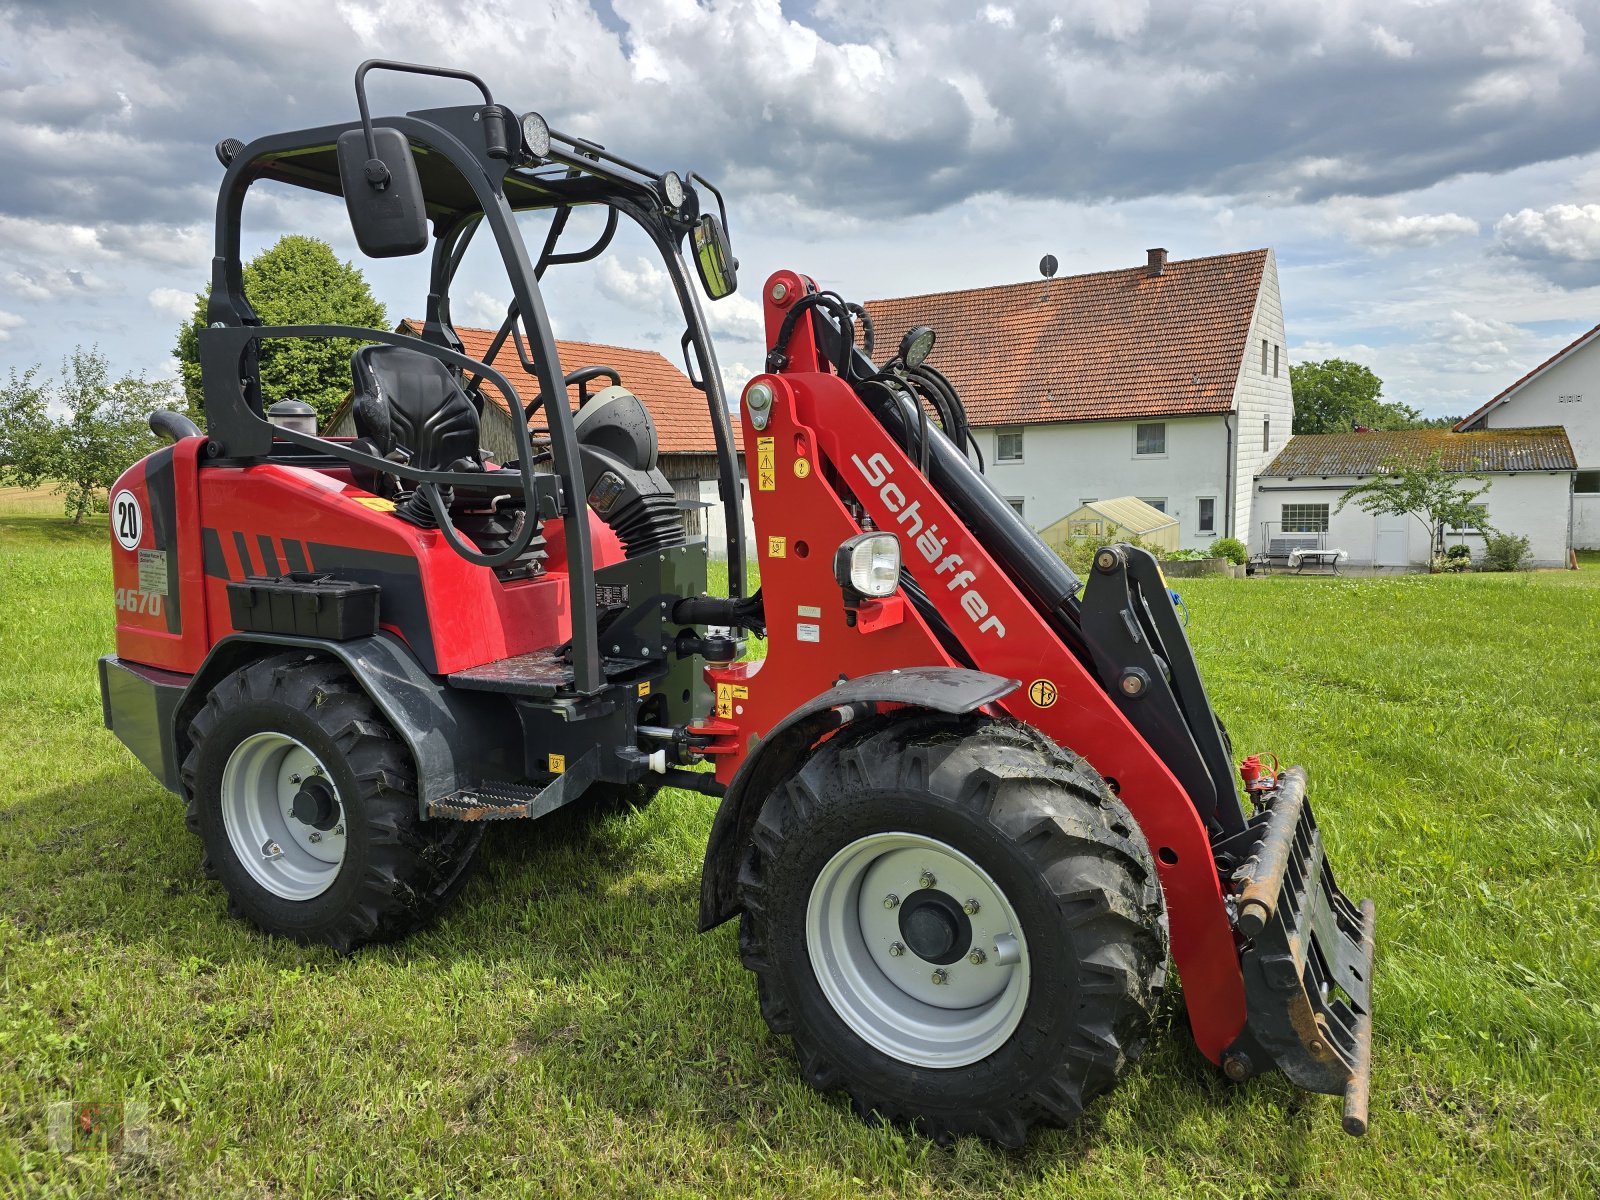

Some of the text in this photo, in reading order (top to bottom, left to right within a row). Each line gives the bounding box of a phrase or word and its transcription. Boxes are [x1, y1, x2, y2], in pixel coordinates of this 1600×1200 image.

[119, 502, 137, 539] 20
[851, 453, 1006, 638] Schäffer
[116, 588, 161, 616] 4670
